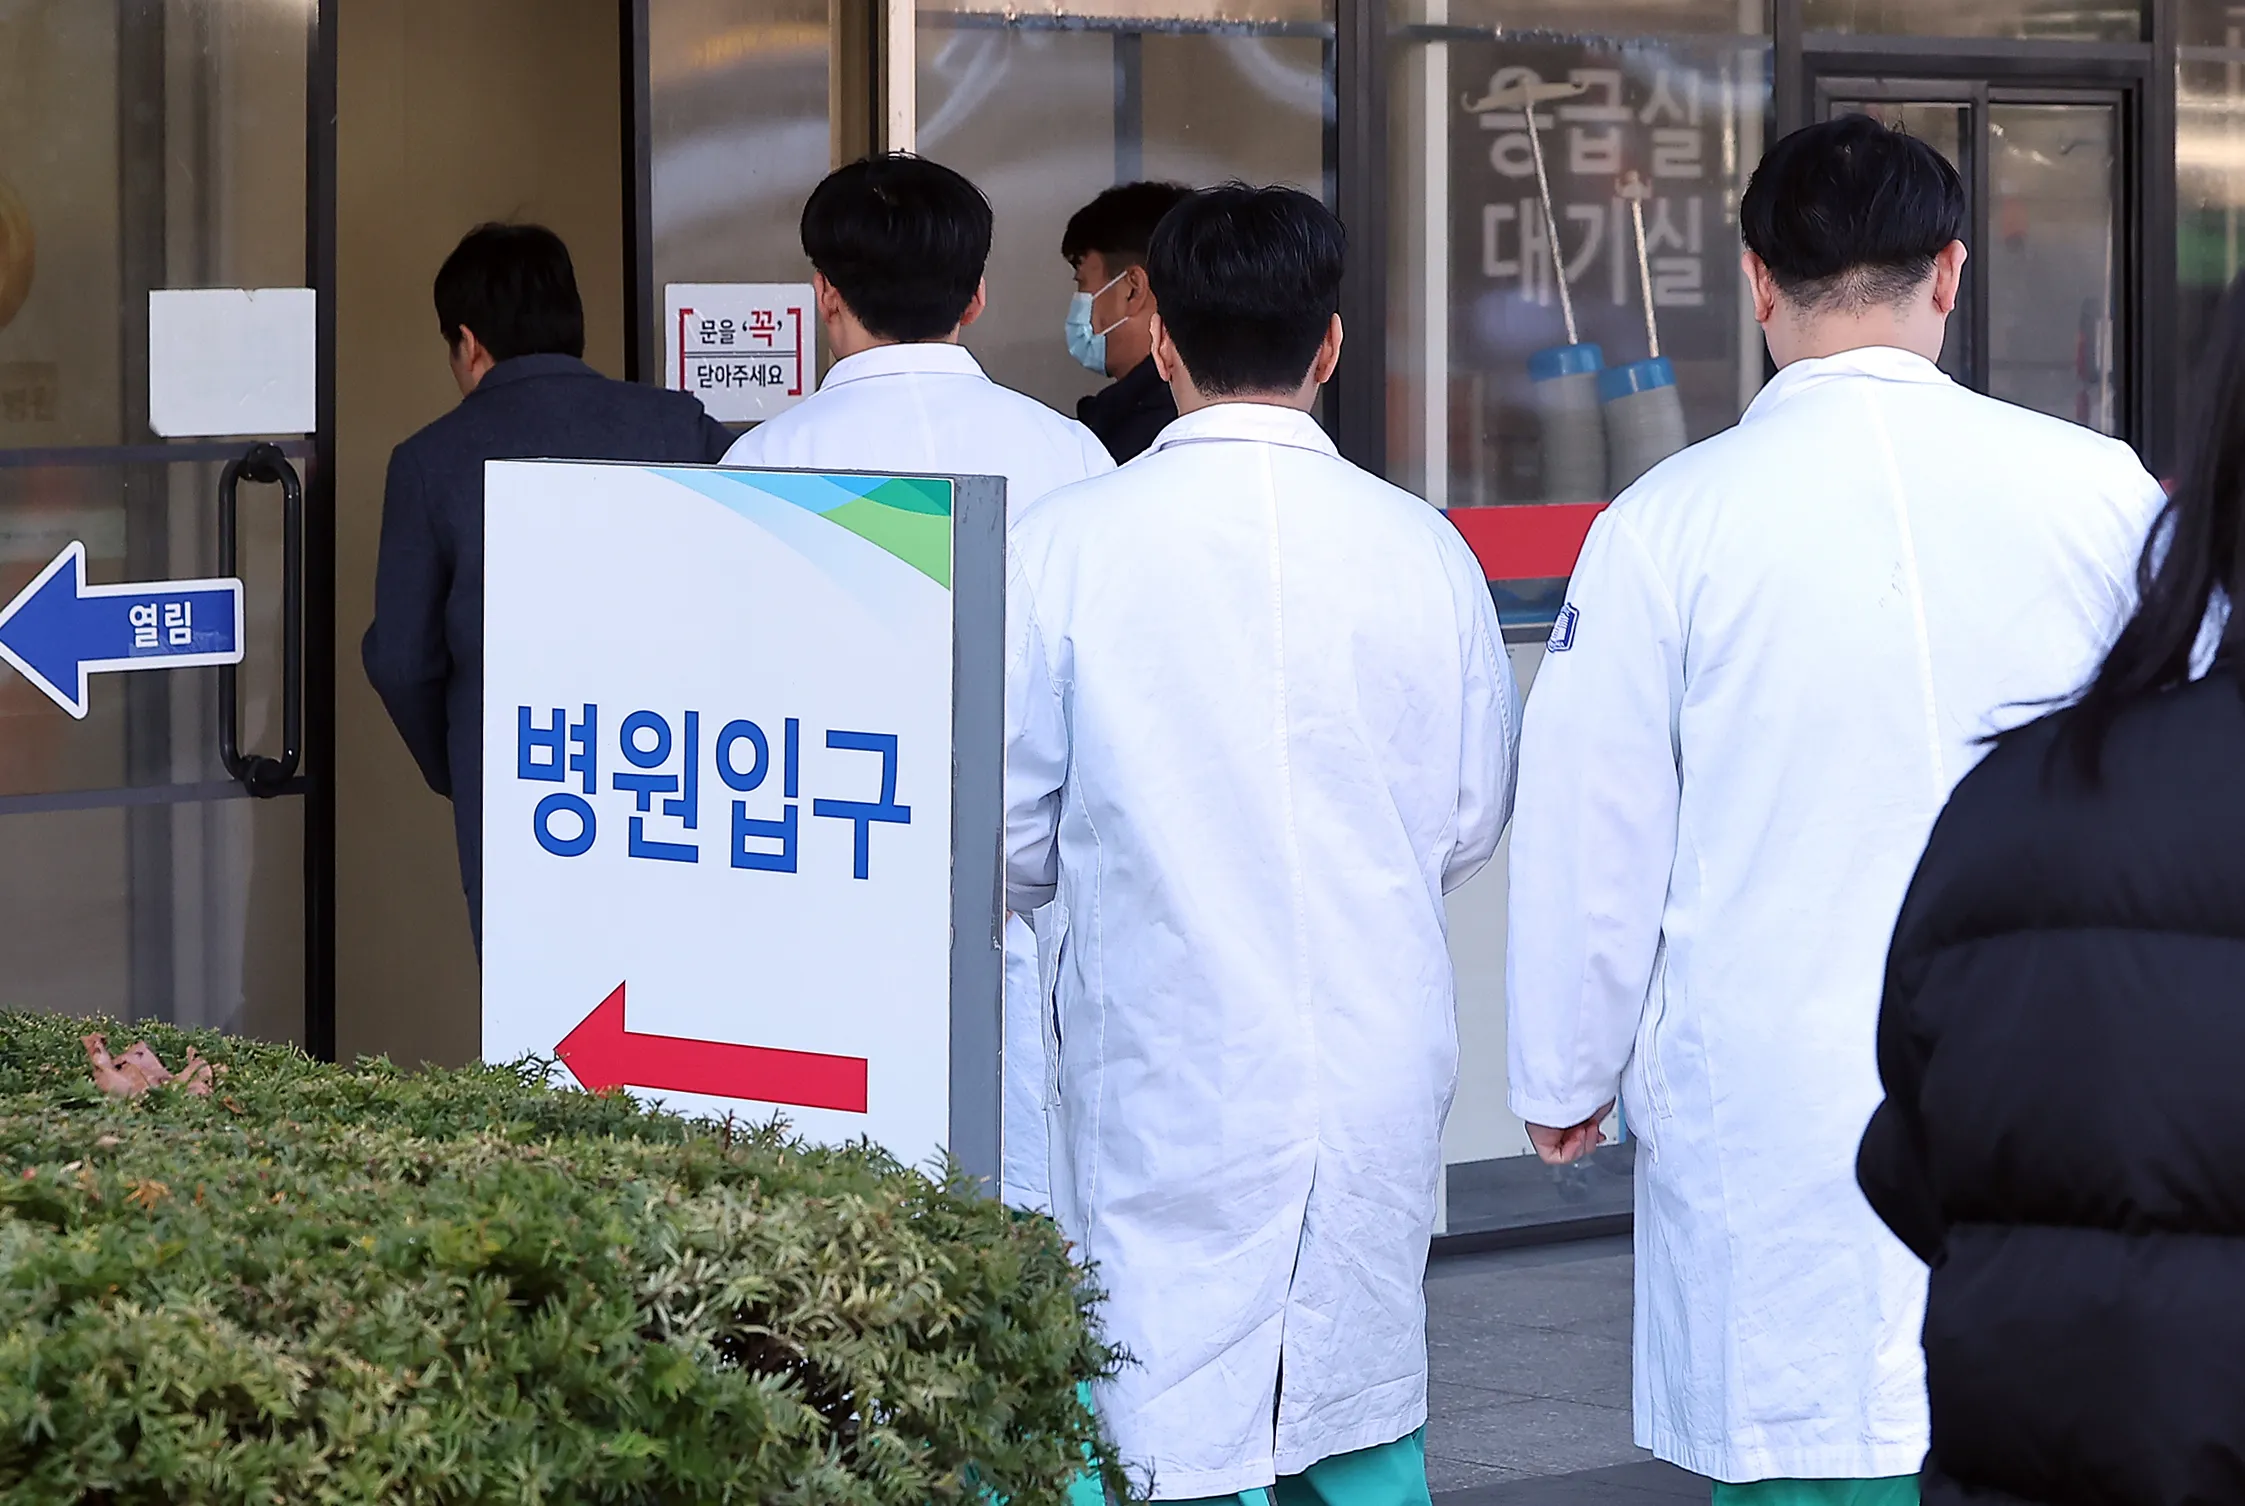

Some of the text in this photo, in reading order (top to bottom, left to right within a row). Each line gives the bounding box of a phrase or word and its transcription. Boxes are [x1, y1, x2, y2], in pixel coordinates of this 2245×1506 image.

[1479, 66, 1703, 179] 응급실
[1482, 197, 1705, 307] 대기실
[699, 318, 737, 346] 문을
[697, 363, 784, 389] 닫아주세요
[128, 601, 194, 648] 열림
[517, 703, 911, 880] 병원입구
